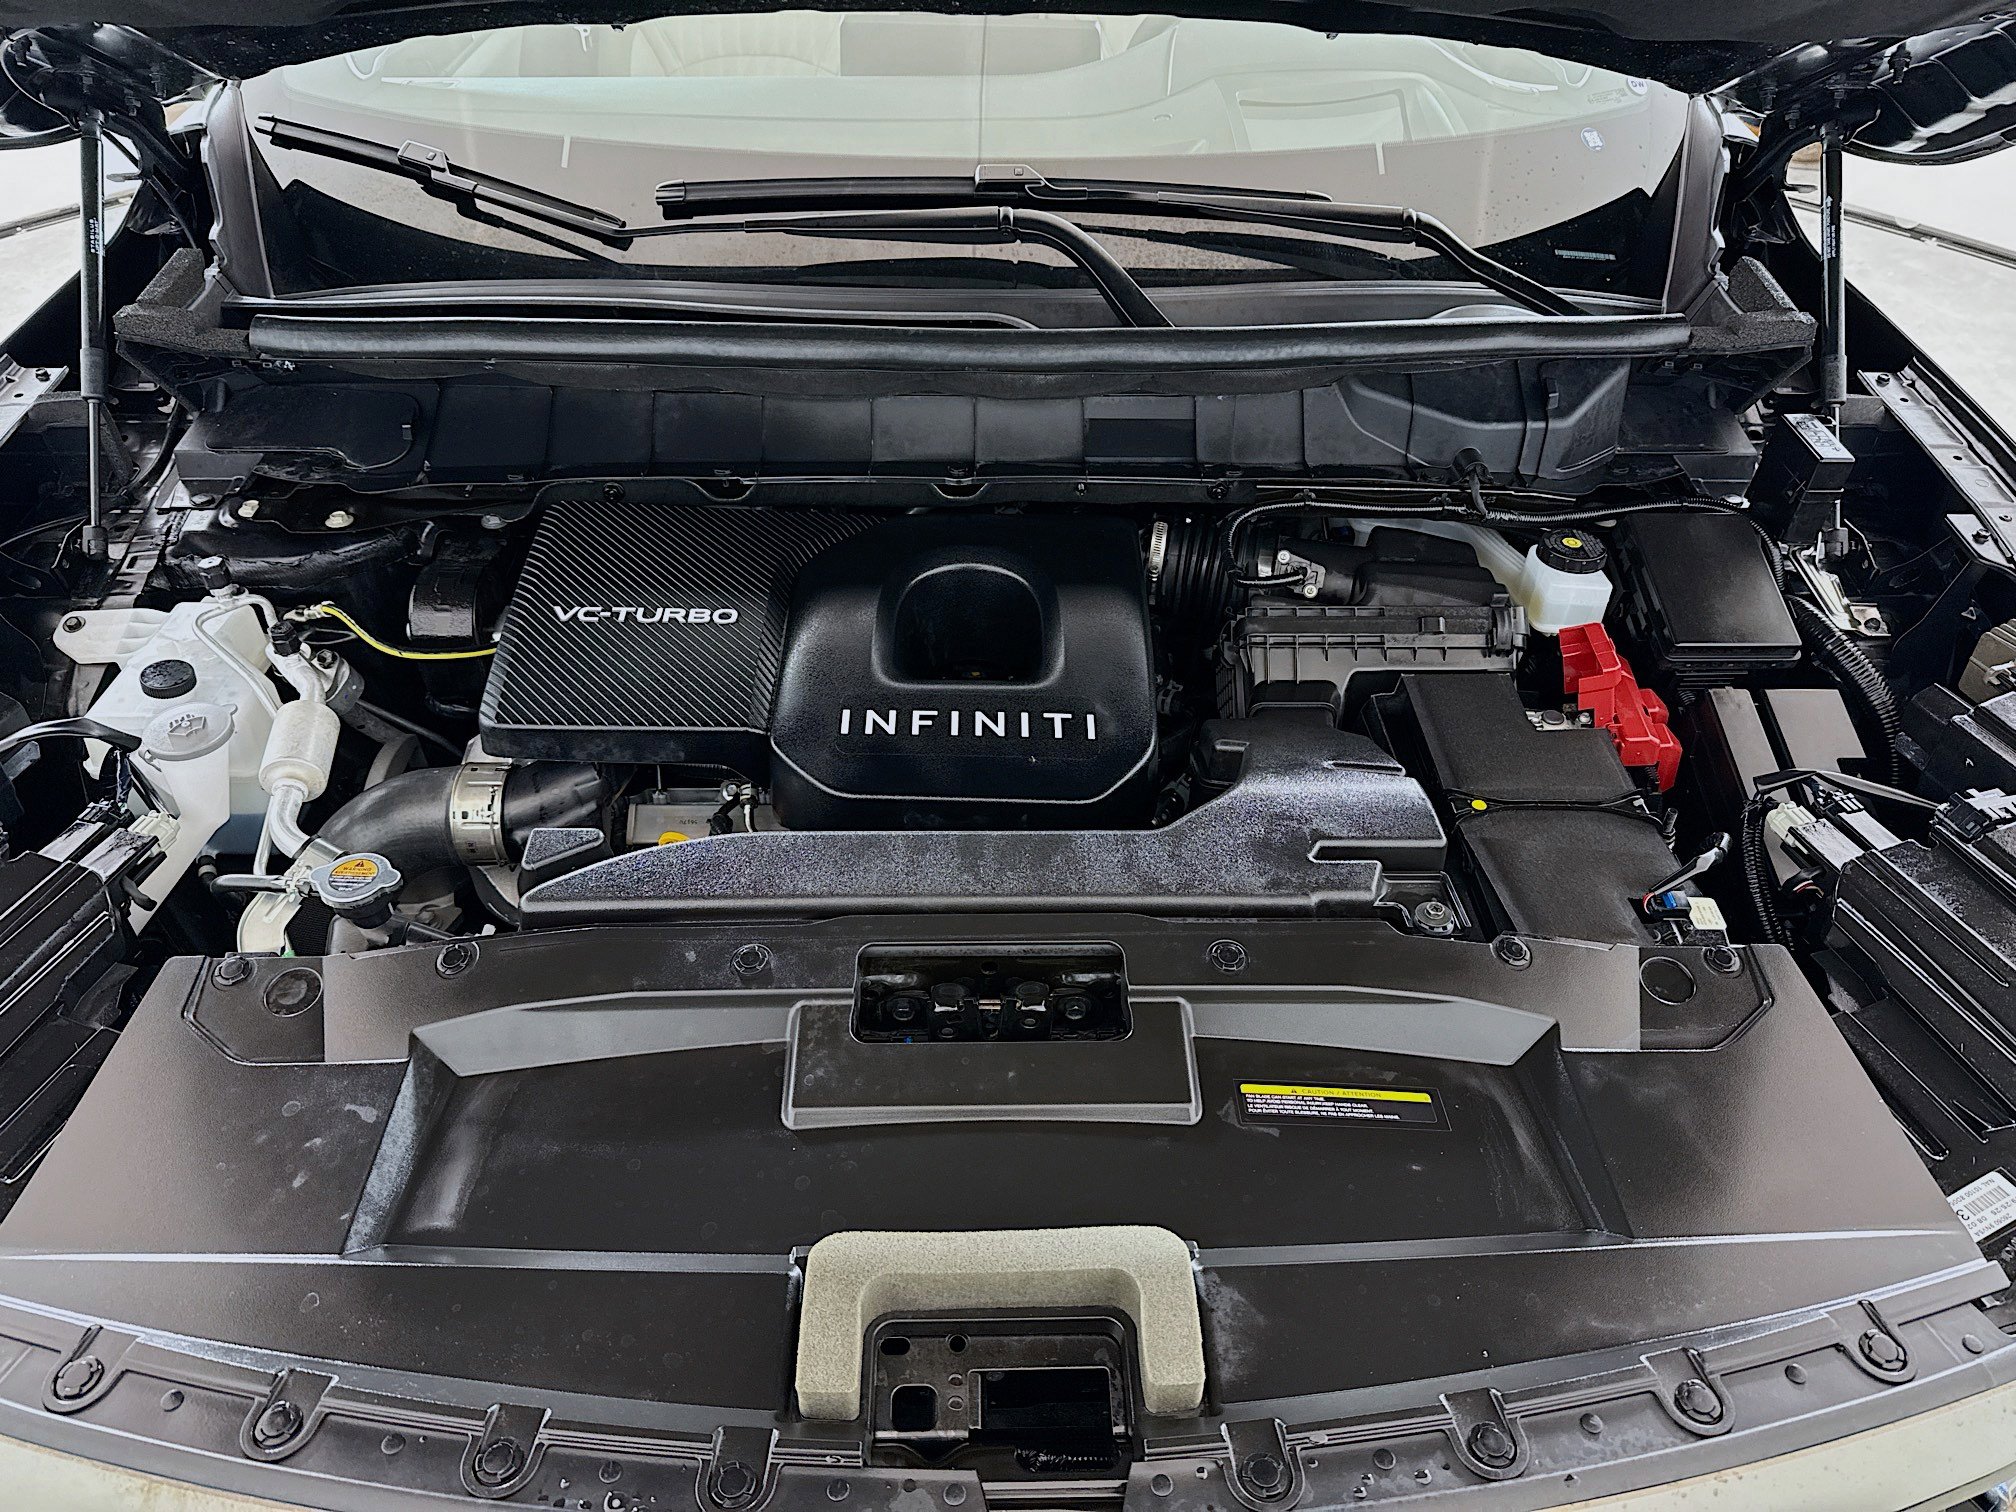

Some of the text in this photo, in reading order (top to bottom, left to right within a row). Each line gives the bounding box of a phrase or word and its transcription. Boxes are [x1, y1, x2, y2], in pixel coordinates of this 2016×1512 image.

[553, 605, 739, 625] VC-TURBO
[840, 708, 1096, 740] INFINITI
[1956, 1209, 1970, 1220] 3
